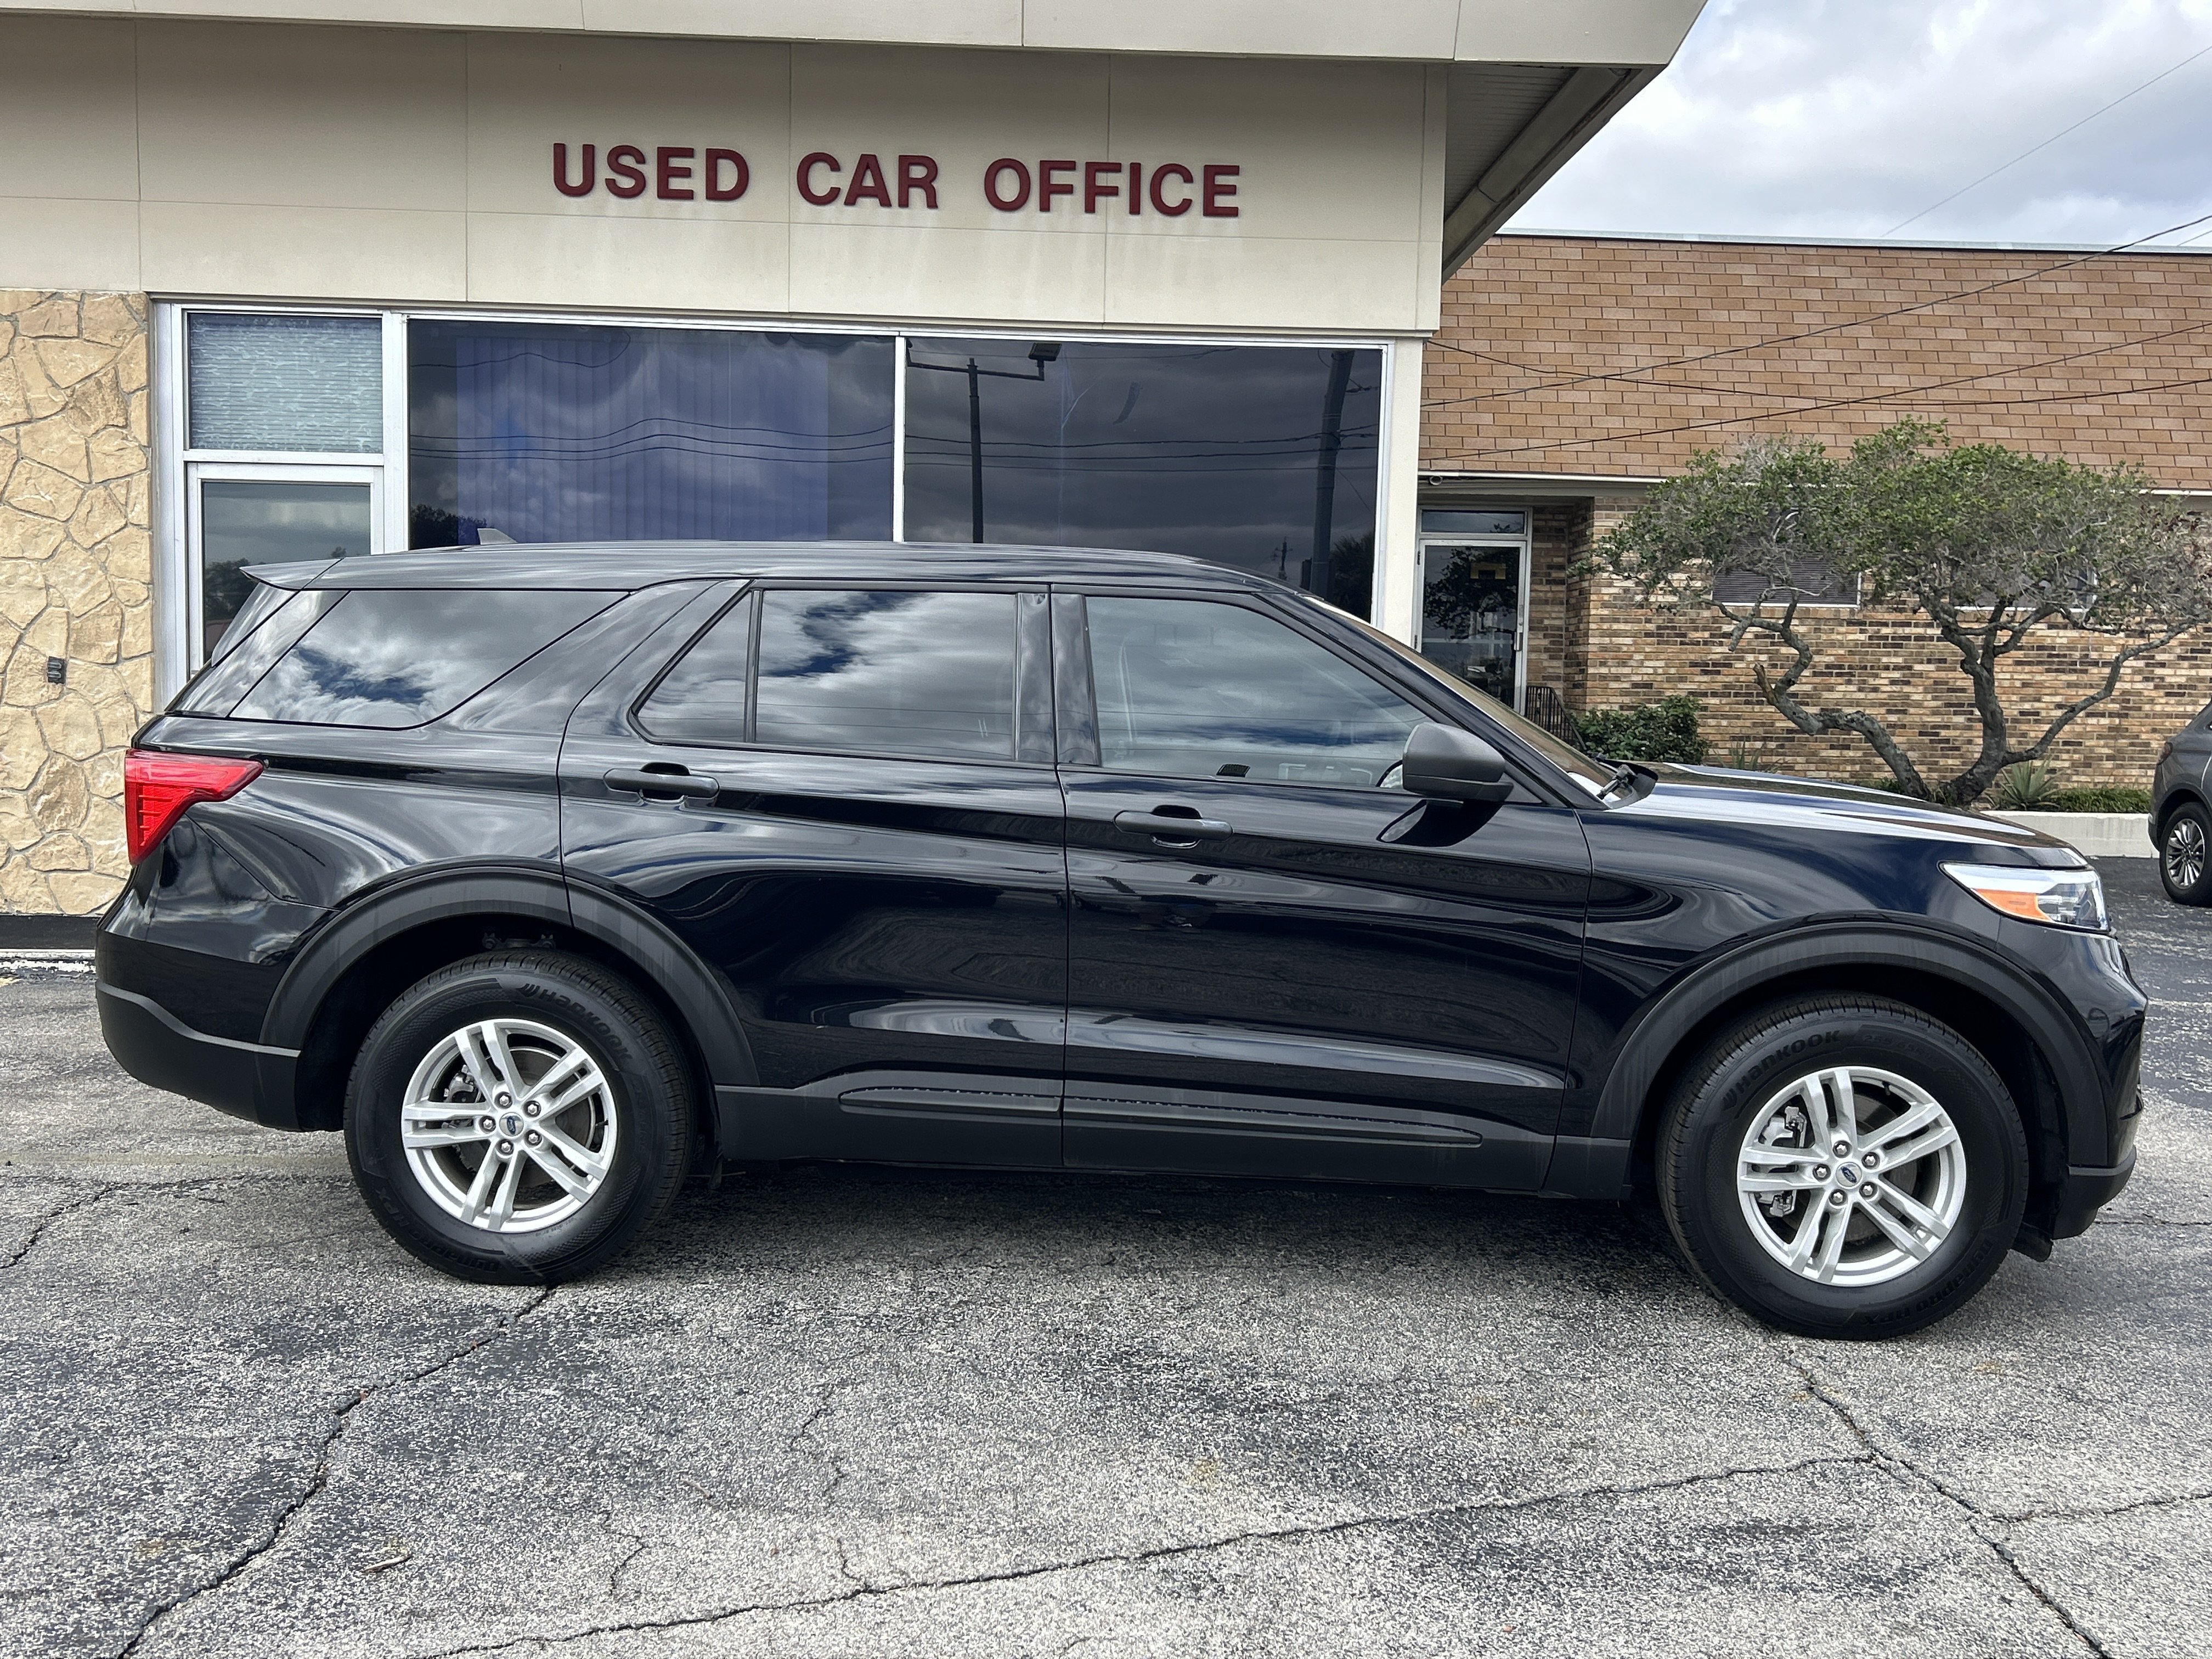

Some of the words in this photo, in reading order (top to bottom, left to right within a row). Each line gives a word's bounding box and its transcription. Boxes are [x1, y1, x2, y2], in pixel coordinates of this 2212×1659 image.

[553, 143, 749, 201] USED
[796, 153, 938, 208] CAR
[983, 158, 1239, 217] OFFICE
